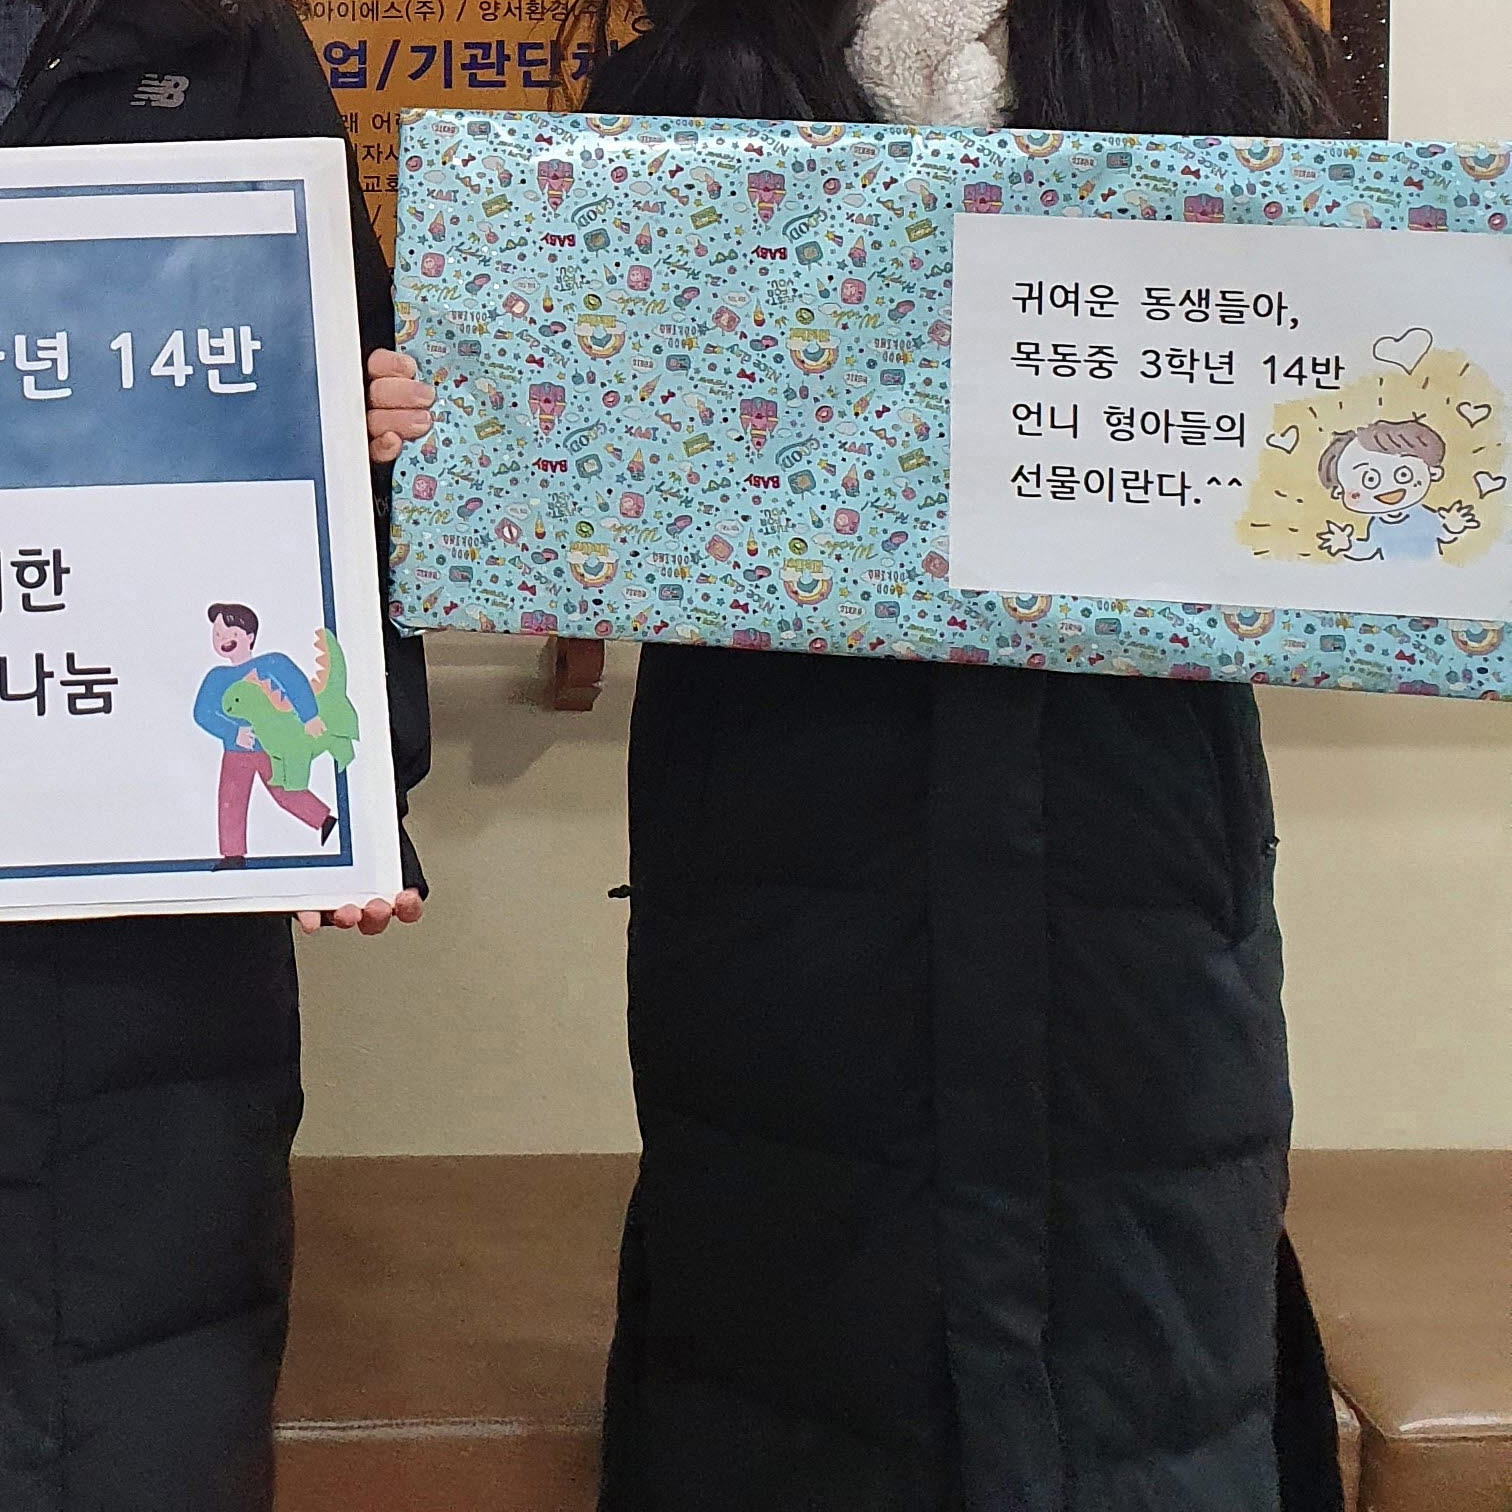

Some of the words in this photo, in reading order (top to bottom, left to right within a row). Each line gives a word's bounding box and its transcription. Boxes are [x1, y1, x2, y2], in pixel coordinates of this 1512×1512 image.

[1012, 280, 1119, 320] 귀여운
[1140, 288, 1300, 330] 동생들아,
[110, 326, 261, 397] 14반
[1010, 343, 1118, 379] 목동중
[1140, 348, 1235, 386] 3학년
[1262, 354, 1346, 392] 14반
[1012, 402, 1079, 439] 언니
[1104, 406, 1247, 449] 형아들의
